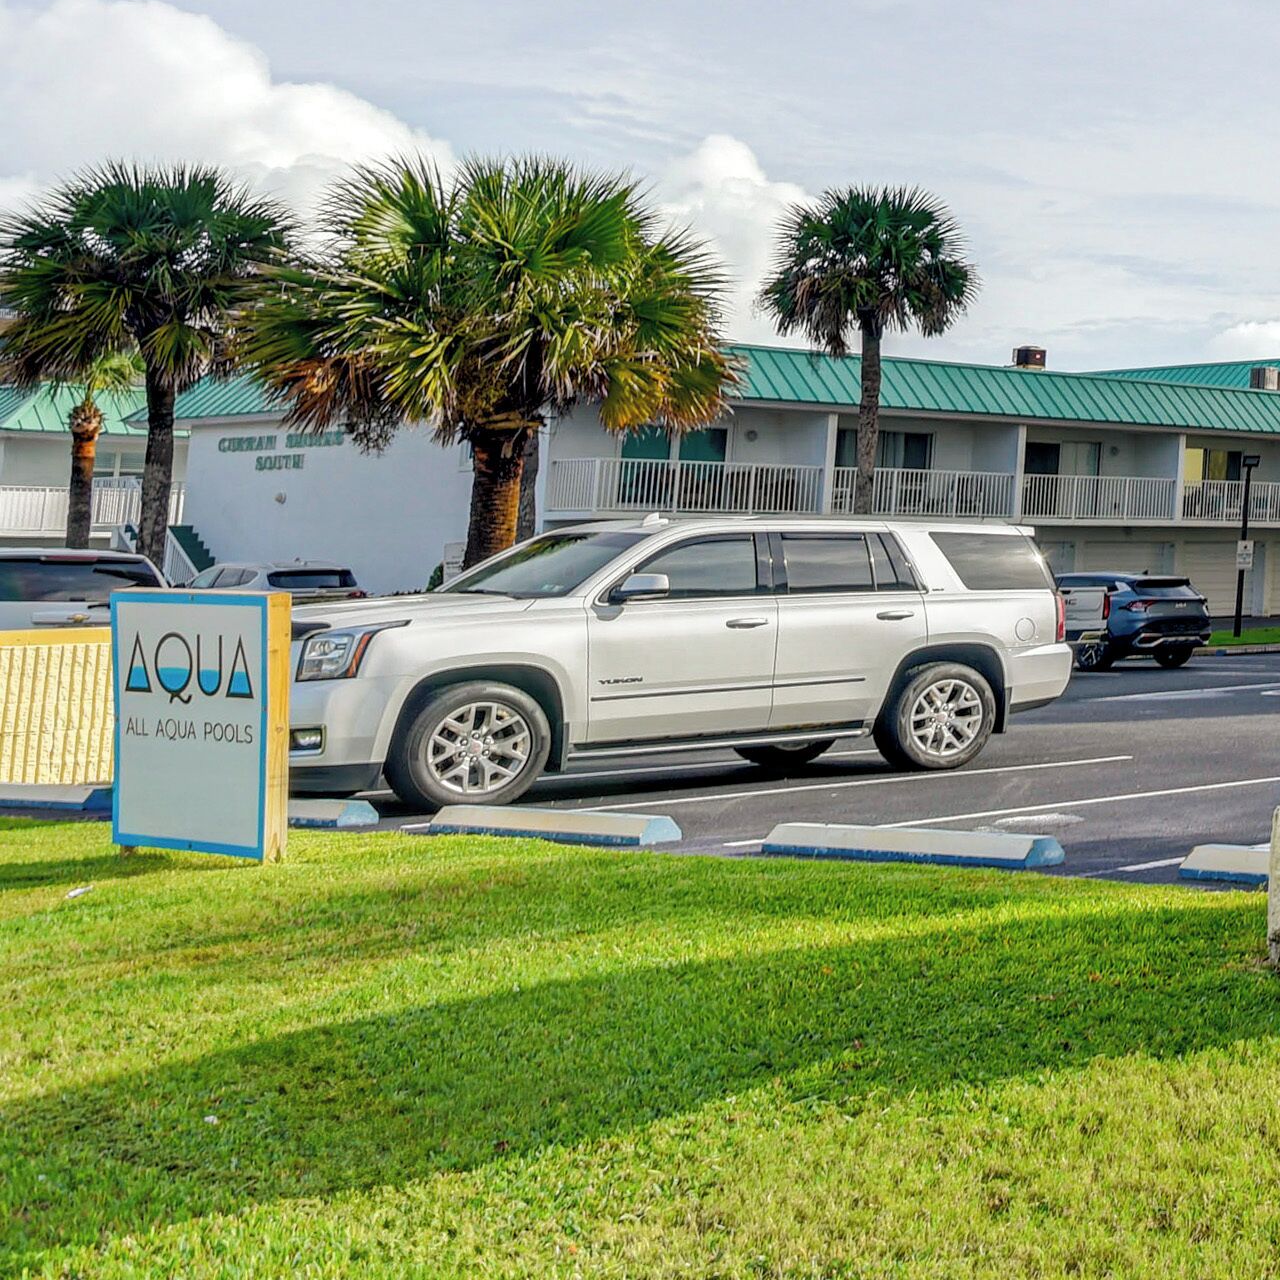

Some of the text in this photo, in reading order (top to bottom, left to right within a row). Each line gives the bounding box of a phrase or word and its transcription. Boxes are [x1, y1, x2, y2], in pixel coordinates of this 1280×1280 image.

[255, 453, 306, 471] SOUTH
[125, 630, 254, 705] AQUA
[598, 676, 643, 685] YUKON
[126, 717, 253, 745] ALL AQUA POOLS
